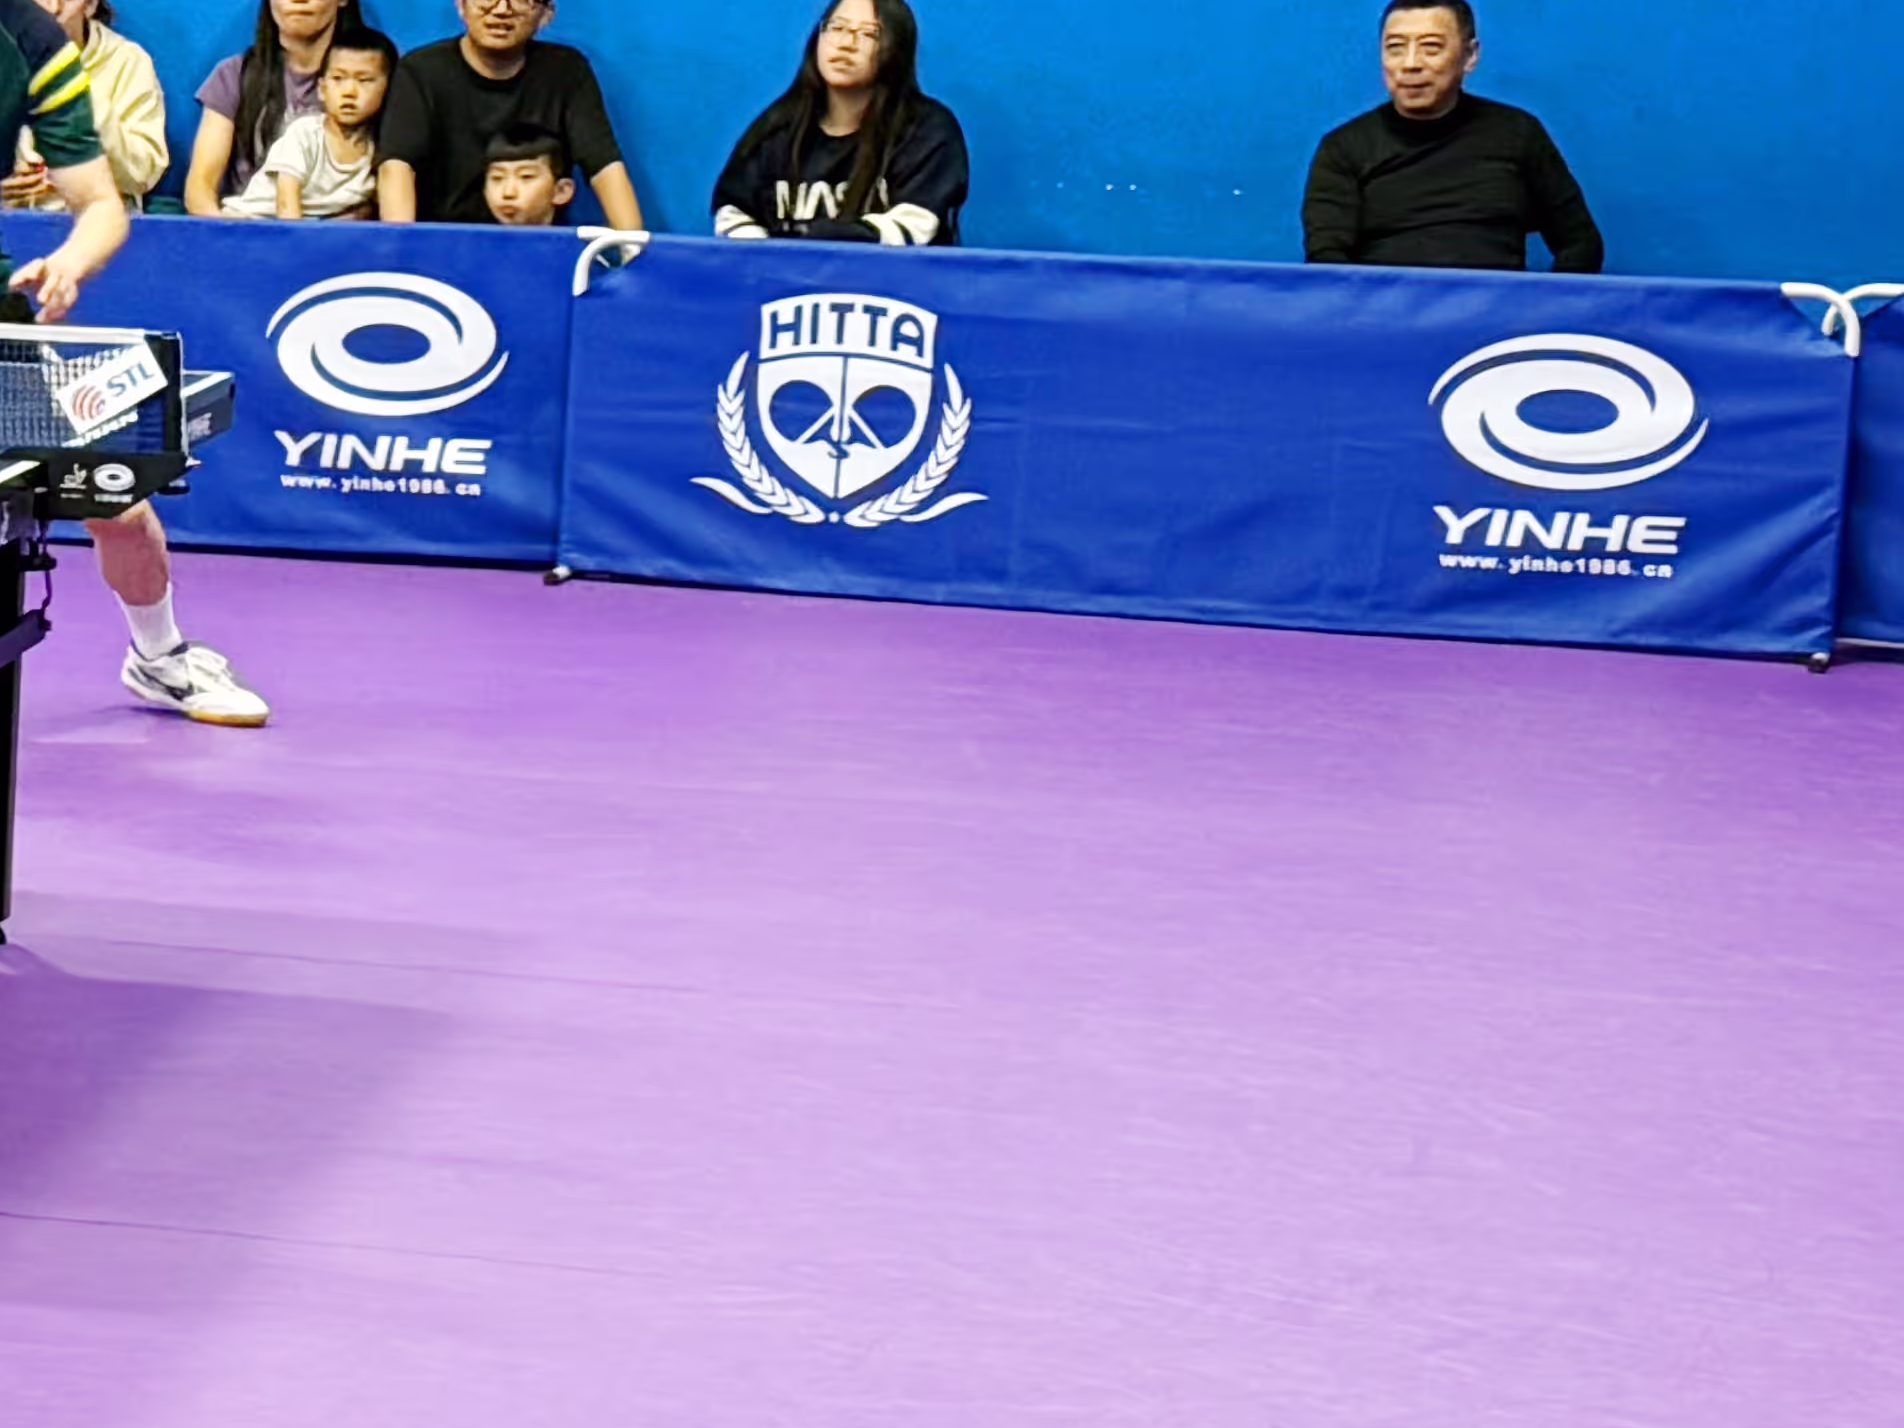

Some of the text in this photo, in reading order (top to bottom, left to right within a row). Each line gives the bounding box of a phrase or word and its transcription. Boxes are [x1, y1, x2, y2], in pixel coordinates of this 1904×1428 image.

[768, 302, 926, 360] HITTA
[106, 361, 155, 398] STL
[273, 429, 493, 475] YINHE
[1432, 504, 1688, 555] YINHE
